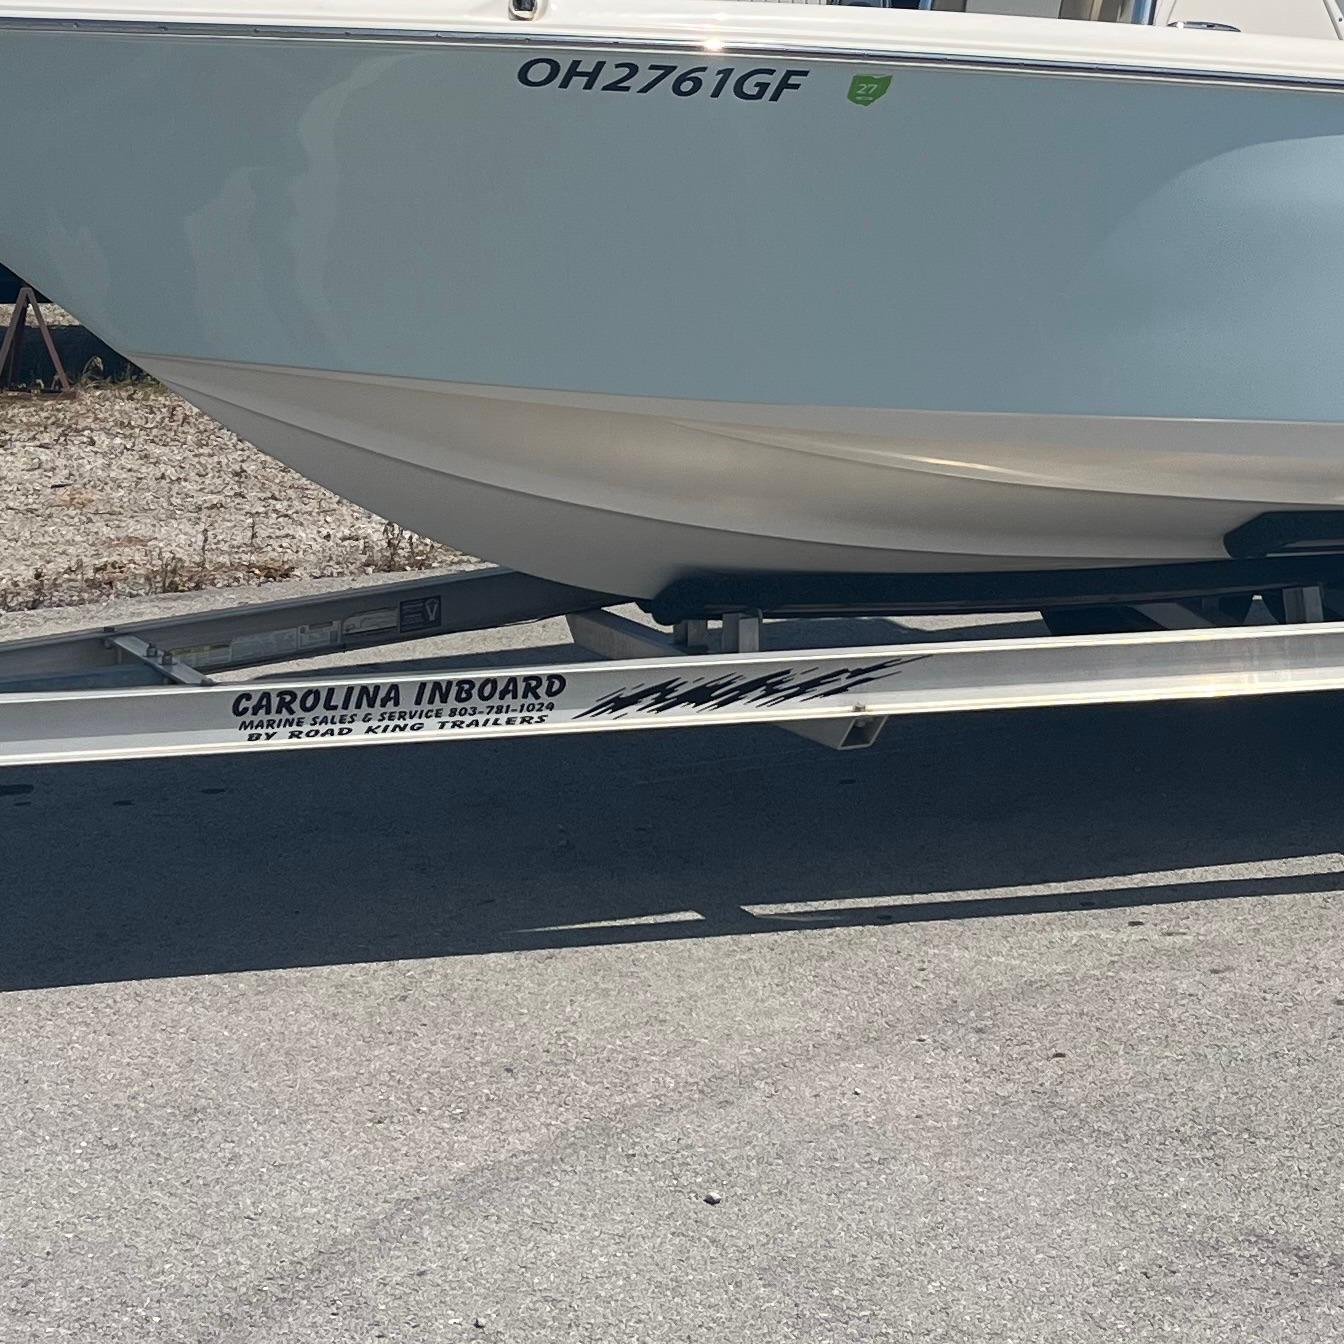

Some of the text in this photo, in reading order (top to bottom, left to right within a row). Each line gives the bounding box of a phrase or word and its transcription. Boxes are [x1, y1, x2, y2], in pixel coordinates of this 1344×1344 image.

[517, 57, 810, 102] OH2761GF
[856, 83, 878, 94] 27
[232, 674, 567, 717] CAROLINA INBOARD
[238, 701, 556, 731] MARINE SALES & SERVICE 803-781-1024
[247, 714, 549, 742] BY ROAD KING TRAILERS
